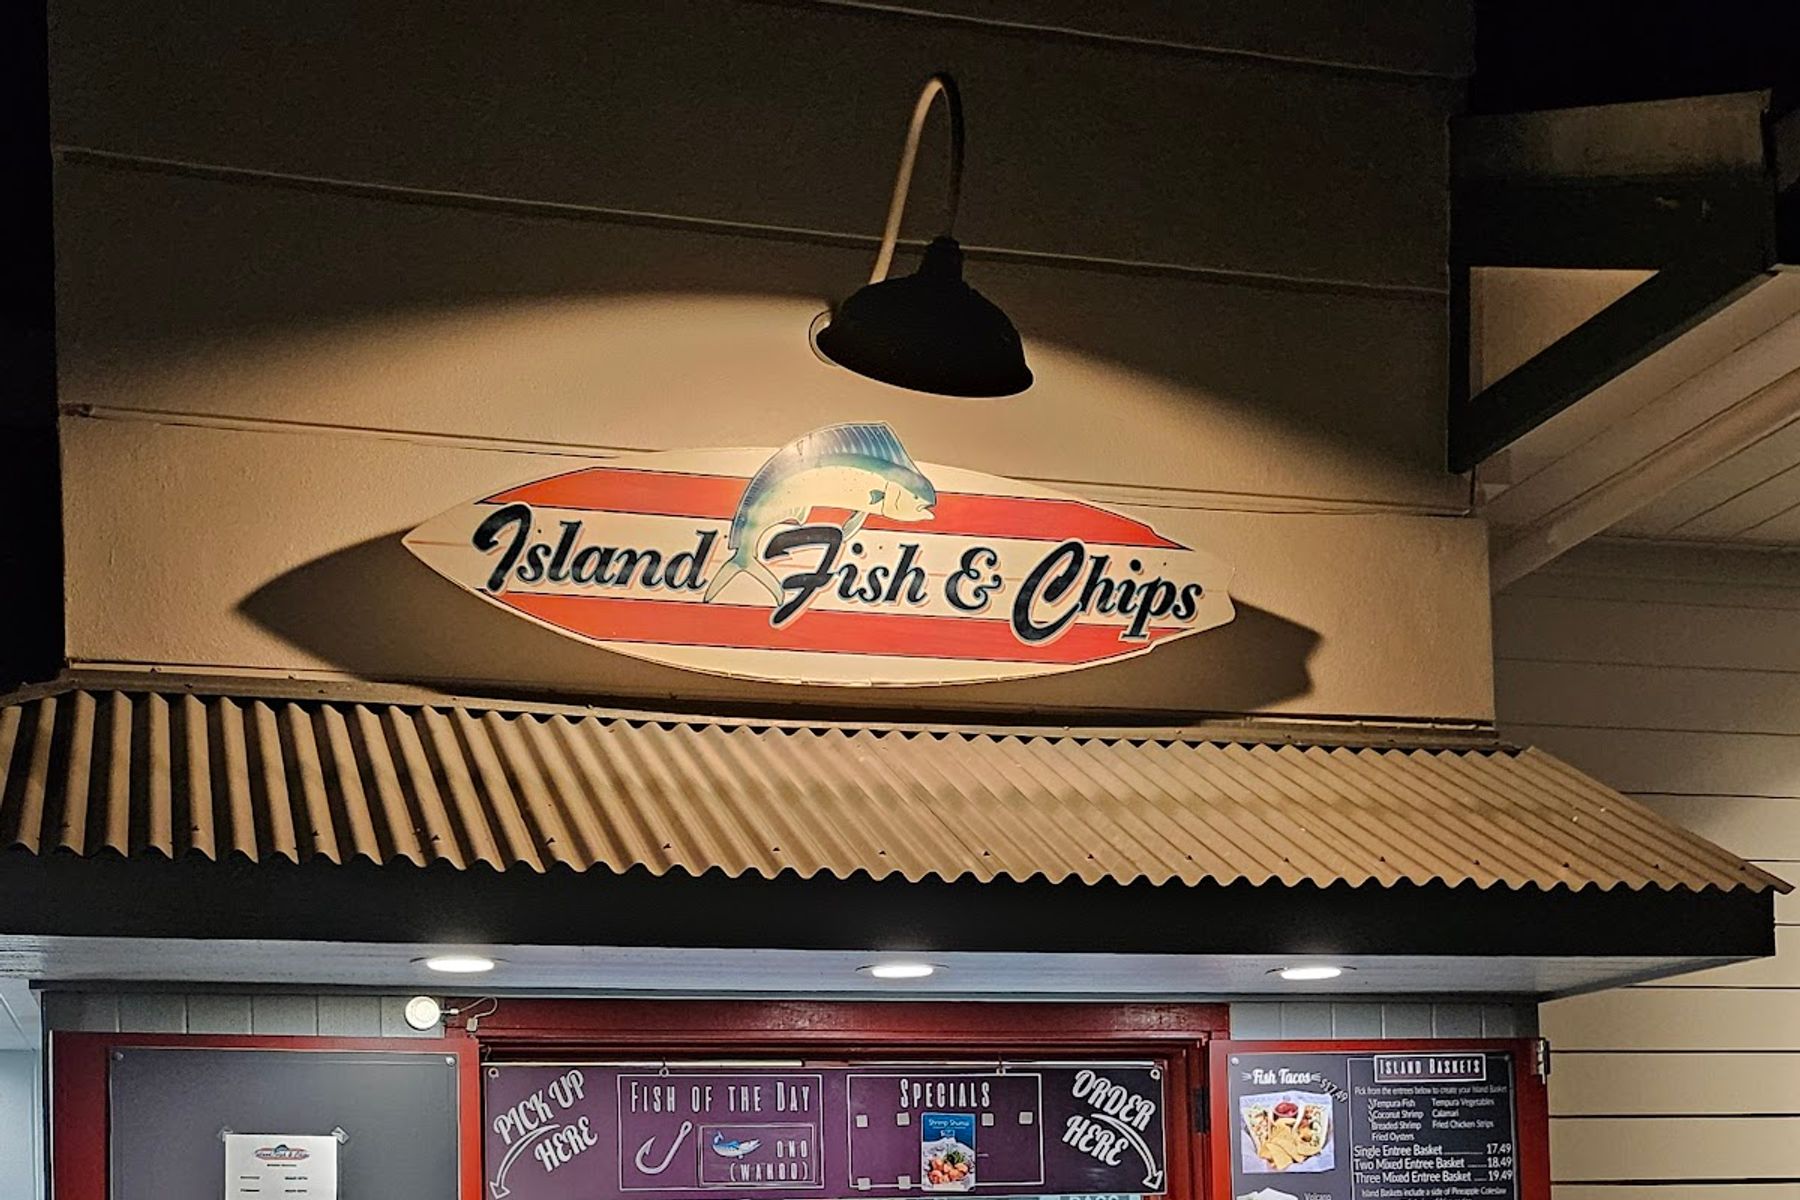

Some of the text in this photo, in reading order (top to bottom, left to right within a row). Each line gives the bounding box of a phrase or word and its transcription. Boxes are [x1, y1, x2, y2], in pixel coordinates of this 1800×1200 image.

[472, 503, 1205, 644] Island Fish & Chips
[1252, 1067, 1311, 1084] Fish Tacos
[493, 1069, 586, 1145] PICK UP
[1071, 1069, 1156, 1132] ORDER
[1401, 1110, 1424, 1119] Shrimp
[534, 1116, 598, 1172] HERE
[1062, 1115, 1130, 1166] HERE
[1371, 1132, 1389, 1141] Fried
[776, 1140, 808, 1158] ONO
[1354, 1143, 1512, 1159] Single Entree Basket 17.49
[729, 1161, 809, 1182] (WAHOO)
[1353, 1157, 1512, 1171] Two Mixed Entree Basket 18.49
[1354, 1170, 1513, 1184] Three Mixed Entree Basket 19.49
